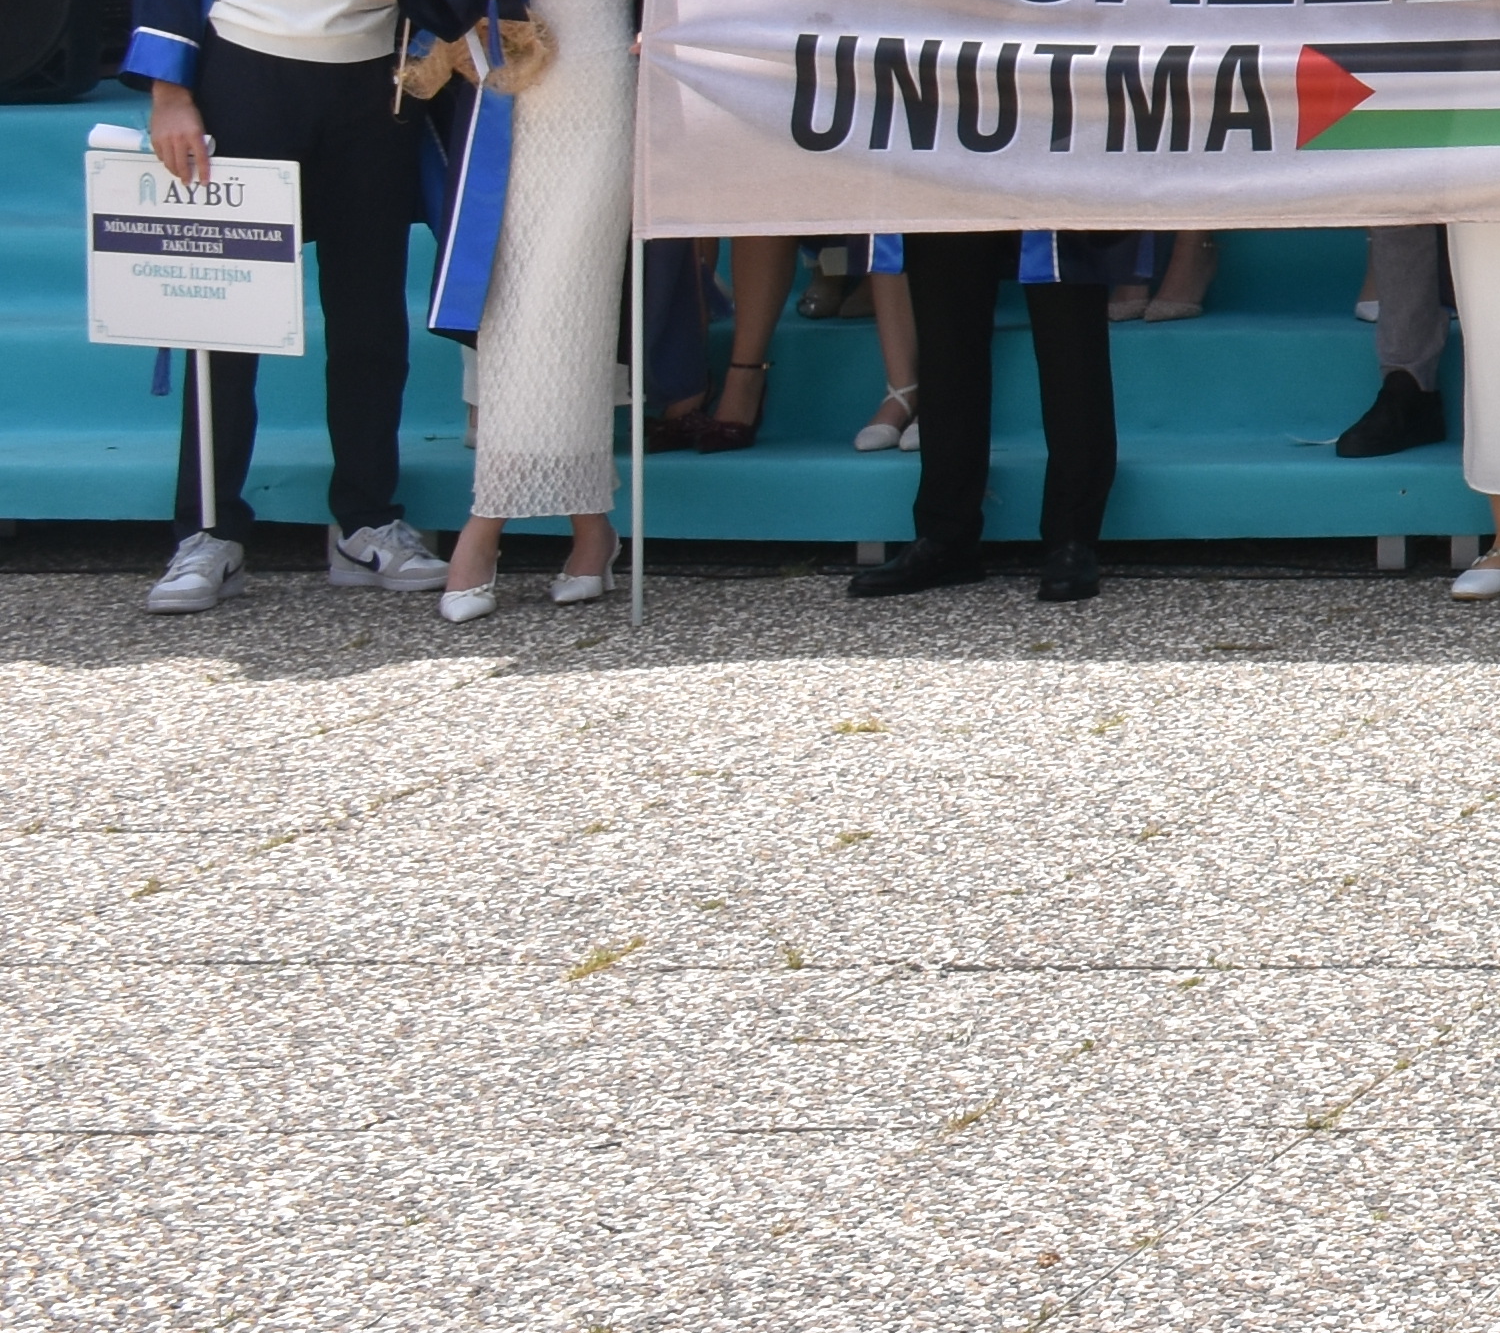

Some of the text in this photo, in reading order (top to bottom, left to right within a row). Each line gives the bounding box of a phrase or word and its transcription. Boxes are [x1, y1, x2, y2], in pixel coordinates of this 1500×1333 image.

[788, 31, 1274, 155] UNUTMA
[163, 176, 246, 208] AYBÜ
[103, 220, 283, 242] MİMARLIK VE GÜZEL SANATLAR
[162, 238, 224, 254] FAKÜLTESİ
[132, 261, 252, 285] GÖRSEL İLETİŞİM
[161, 284, 227, 300] TASARIMI
